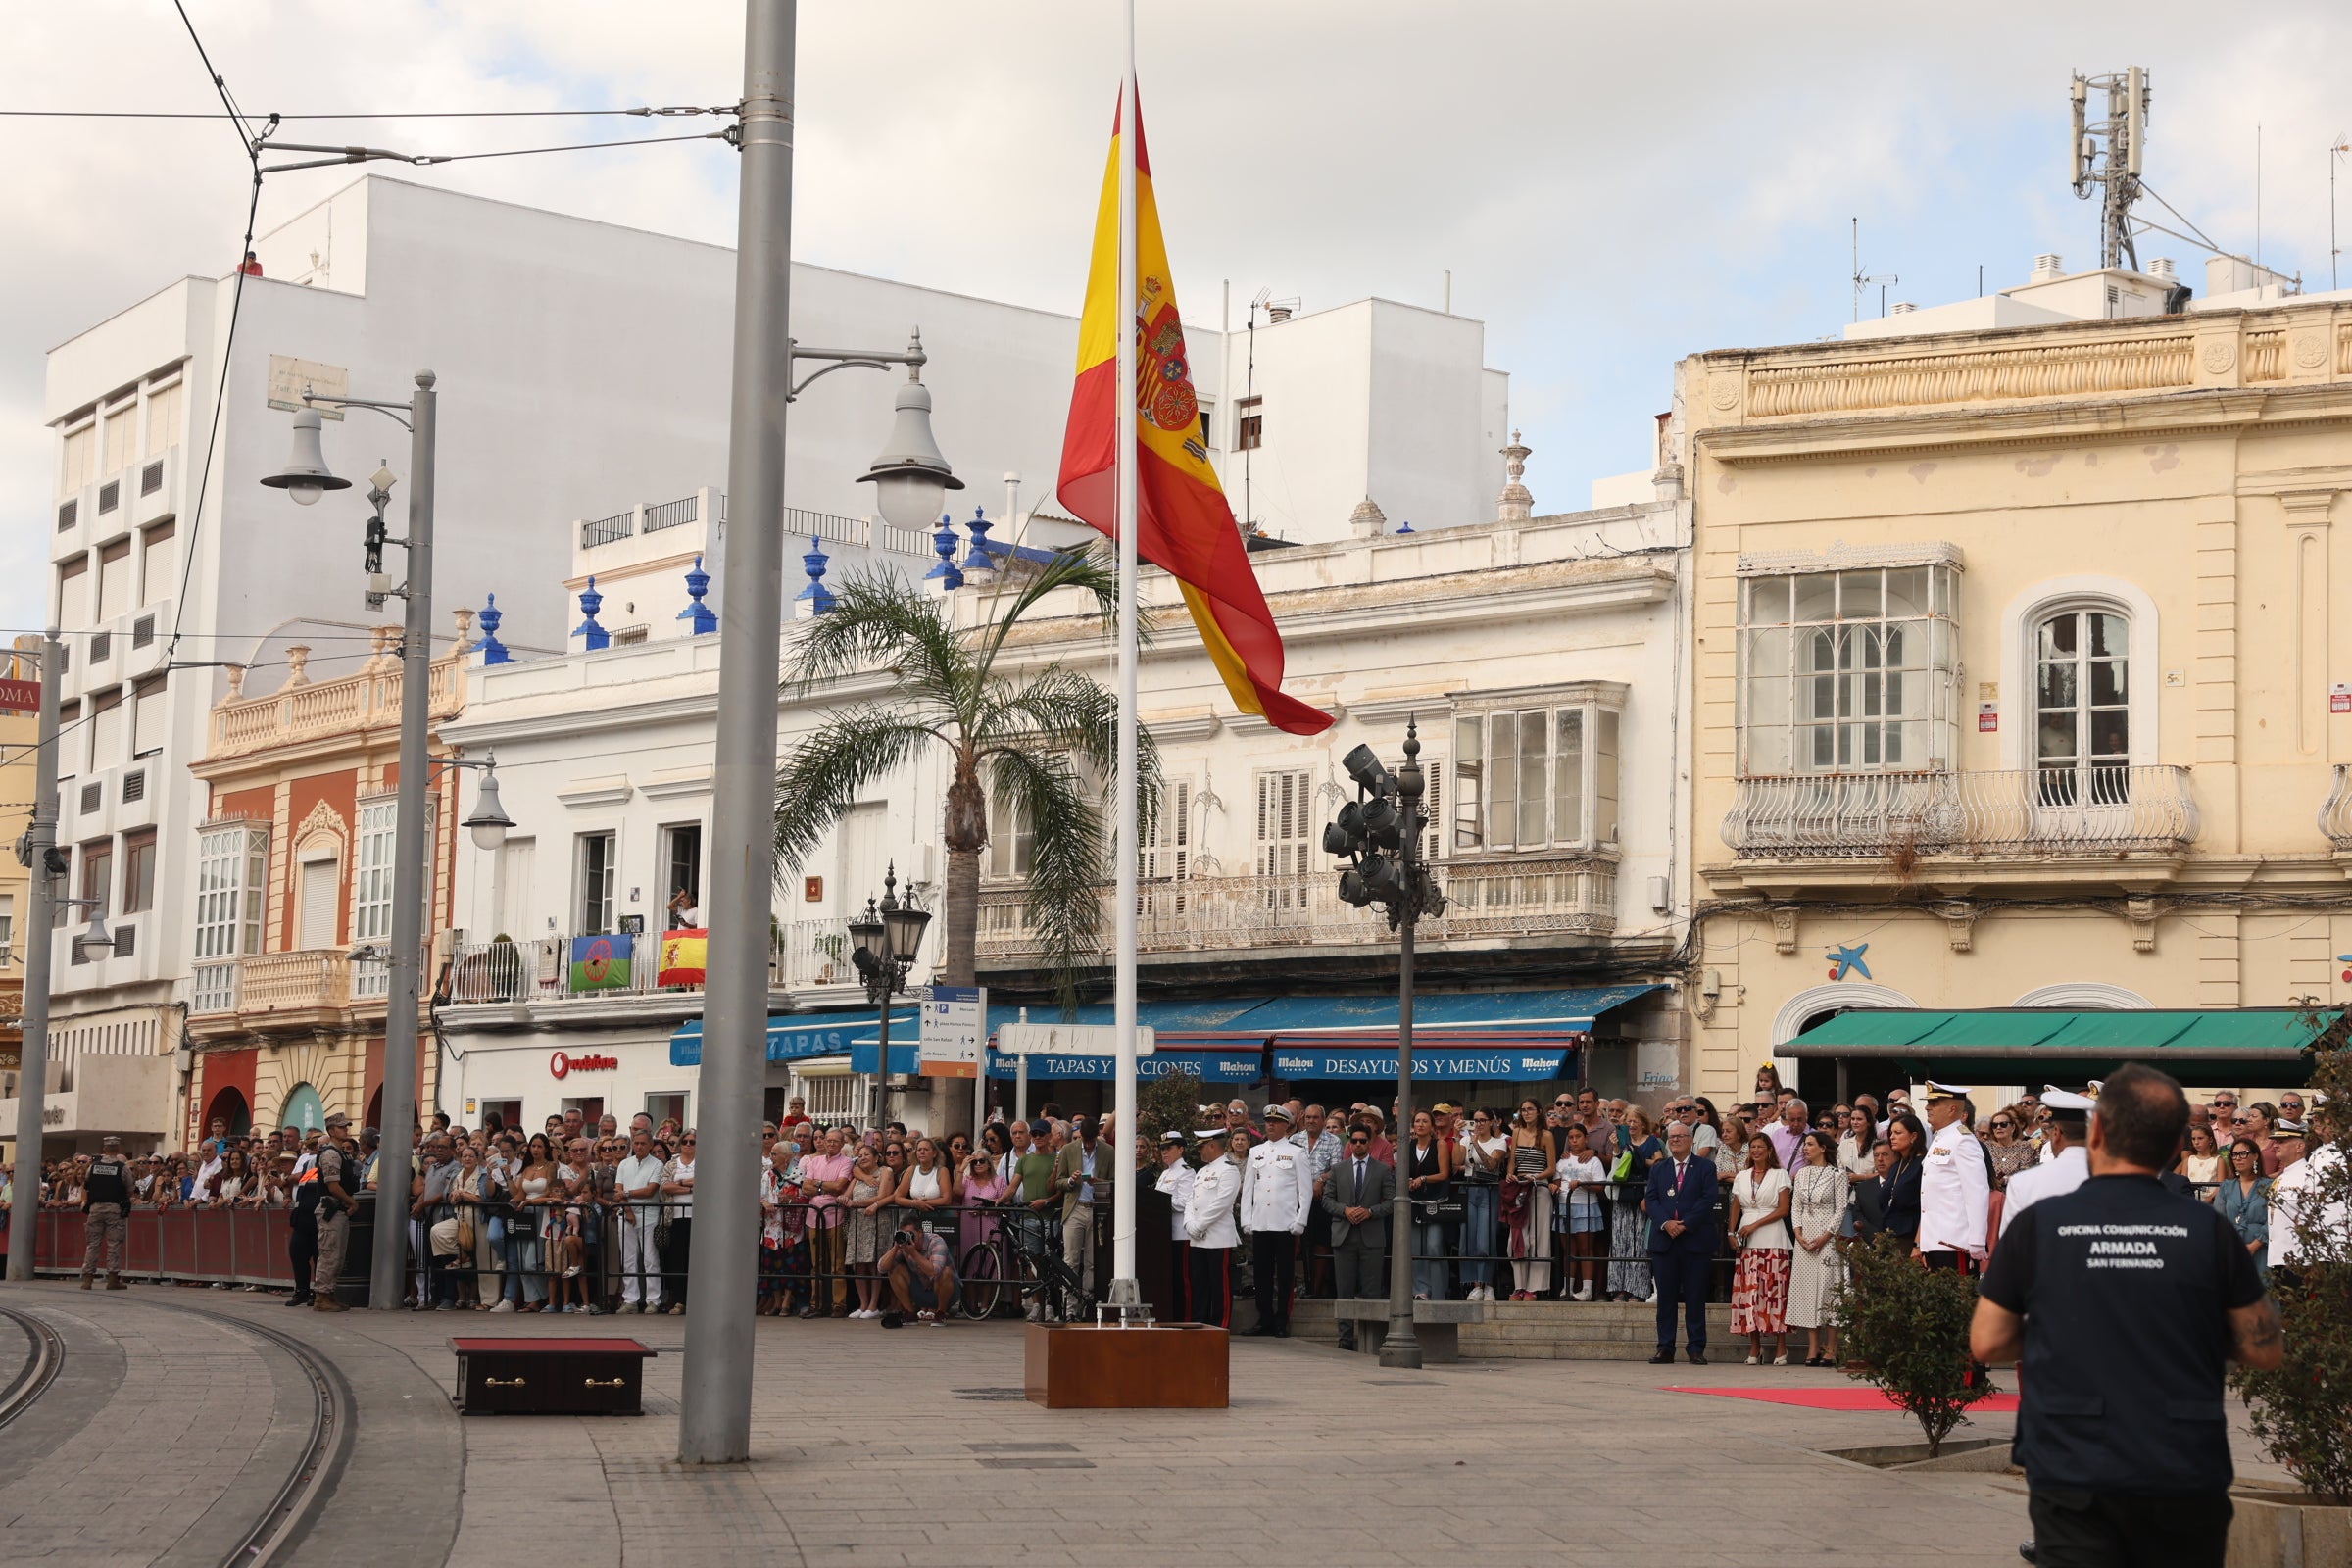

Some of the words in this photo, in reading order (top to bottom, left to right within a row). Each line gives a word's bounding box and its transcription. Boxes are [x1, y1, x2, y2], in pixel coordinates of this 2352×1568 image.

[767, 1032, 841, 1054] TAPAS
[680, 1044, 702, 1055] Mah
[568, 1054, 618, 1071] vodafone
[995, 1058, 1029, 1068] Mah
[1047, 1059, 1096, 1074] TAPAS
[1101, 1060, 1113, 1074] Y
[1136, 1061, 1202, 1075] CIONES
[1219, 1061, 1256, 1072] Mahou
[1278, 1057, 1314, 1068] Mahou
[1433, 1059, 1446, 1074] Y
[1448, 1055, 1511, 1074] MENÚS
[1522, 1057, 1559, 1068] Mahou
[2057, 1225, 2102, 1237] OFICINA
[2102, 1224, 2188, 1238] COMUNICACIÓN
[2089, 1241, 2157, 1255] ARMADA
[2086, 1258, 2108, 1269] SAN
[2109, 1258, 2164, 1269] FERNANDO
